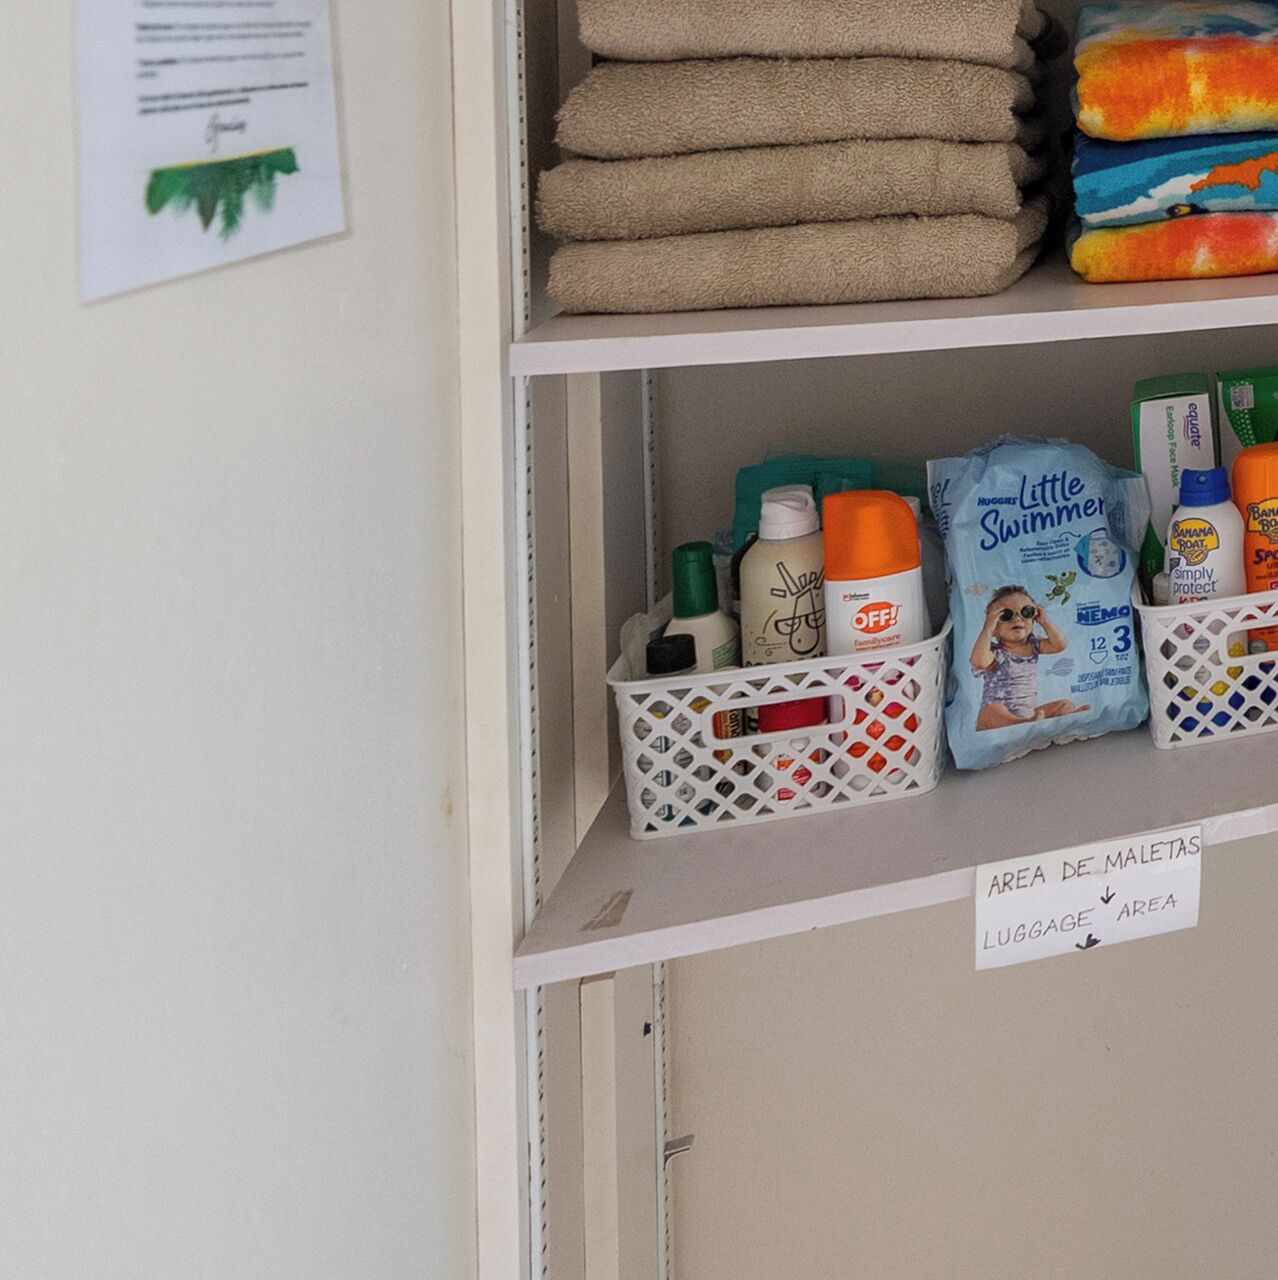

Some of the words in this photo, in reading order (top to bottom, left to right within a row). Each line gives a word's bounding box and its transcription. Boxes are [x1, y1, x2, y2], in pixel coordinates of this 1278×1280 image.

[1166, 405, 1176, 441] Earloop
[1187, 402, 1202, 450] equate
[1168, 441, 1178, 464] Face
[977, 496, 1019, 507] HUGGIES
[1019, 470, 1086, 511] Little
[1171, 520, 1214, 539] BANANA
[1177, 538, 1206, 554] BOAT
[1174, 566, 1215, 582] simply
[1173, 580, 1217, 597] protect
[851, 605, 899, 631] OFF!
[1076, 605, 1131, 623] NEMO
[1090, 636, 1107, 651] 12
[1112, 624, 1132, 654] 3
[987, 865, 1047, 898] AREA
[1061, 856, 1096, 882] DE
[1103, 835, 1201, 873] MALETAS
[982, 907, 1096, 951] LUGGAGE
[1116, 893, 1179, 922] AREA
